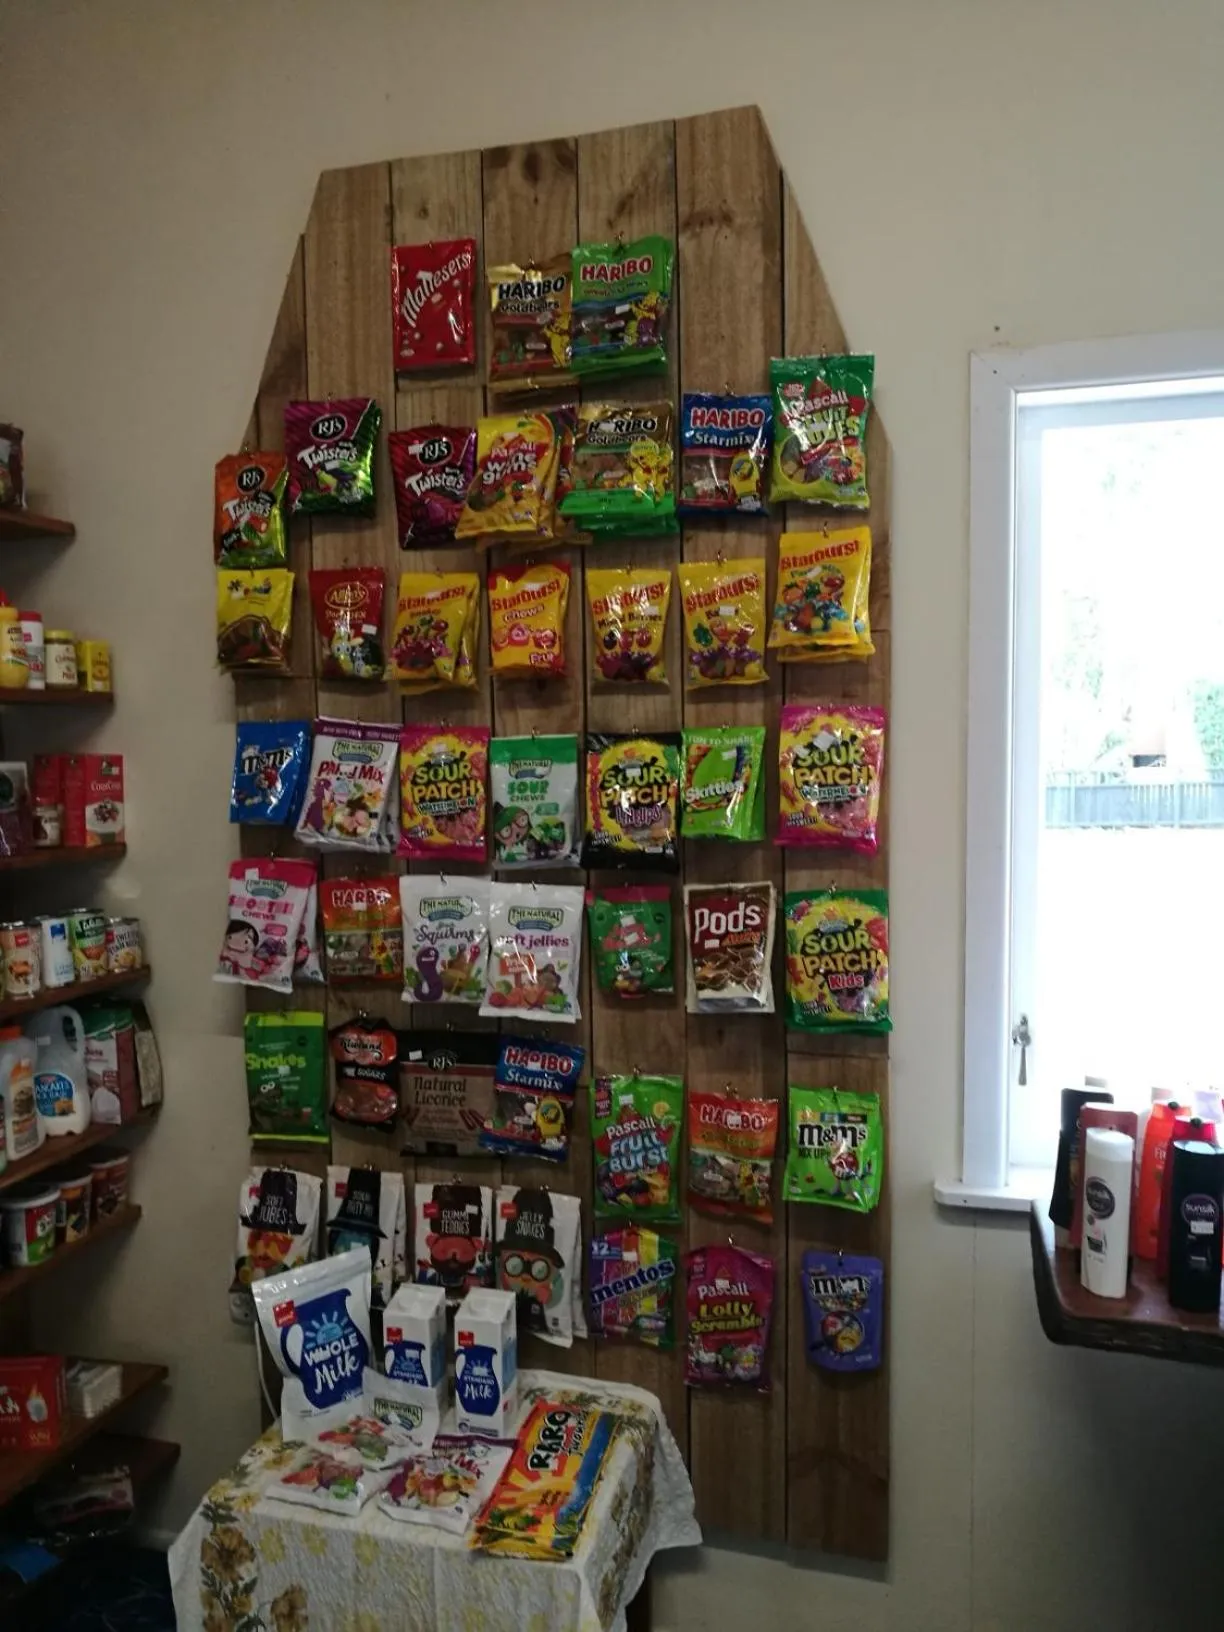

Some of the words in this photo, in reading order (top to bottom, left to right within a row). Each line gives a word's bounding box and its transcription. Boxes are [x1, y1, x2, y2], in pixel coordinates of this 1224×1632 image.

[580, 256, 653, 283] HARIBO
[401, 252, 473, 328] Maltesers
[498, 276, 565, 300] HARIBO
[587, 416, 658, 435] HRIBO
[690, 407, 765, 428] HARIBO
[694, 431, 756, 448] Starmix
[297, 444, 357, 469] Twisters
[405, 472, 466, 497] Twisters
[779, 540, 860, 571] Starburst
[491, 578, 561, 612] Starburst
[685, 574, 761, 612] Starburst
[797, 744, 864, 766] SOUR
[359, 765, 385, 784] MIX
[413, 763, 471, 783] SOUR
[603, 765, 665, 788] SOUR
[794, 765, 867, 787] PATCH
[413, 780, 477, 802] PATCH
[507, 780, 550, 795] SOUR
[509, 793, 546, 802] CHEWS
[686, 779, 744, 804] Skittles
[242, 910, 275, 920] CHEWS
[695, 901, 762, 944] Pods
[416, 924, 475, 945] Squirms
[528, 932, 569, 949] jellies
[805, 930, 871, 954] SOUR
[804, 950, 877, 976] PATCH
[828, 972, 865, 990] Kids
[246, 1053, 306, 1070] Snakes
[505, 1046, 575, 1076] HARIBO
[414, 1077, 467, 1092] Natural
[505, 1068, 561, 1090] Starmix
[415, 1092, 466, 1107] Licorice
[605, 1116, 656, 1139] Pascall
[700, 1103, 765, 1132] HARBO
[441, 1221, 470, 1235] TEDDIES
[515, 1221, 546, 1240] SNAKES
[592, 1242, 609, 1255] 12
[591, 1259, 675, 1305] mentos
[699, 1302, 754, 1318] Lolly
[690, 1316, 764, 1334] Scramble
[304, 1332, 360, 1367] WHOLE
[314, 1350, 360, 1395] Milk
[465, 1383, 493, 1400] Milk
